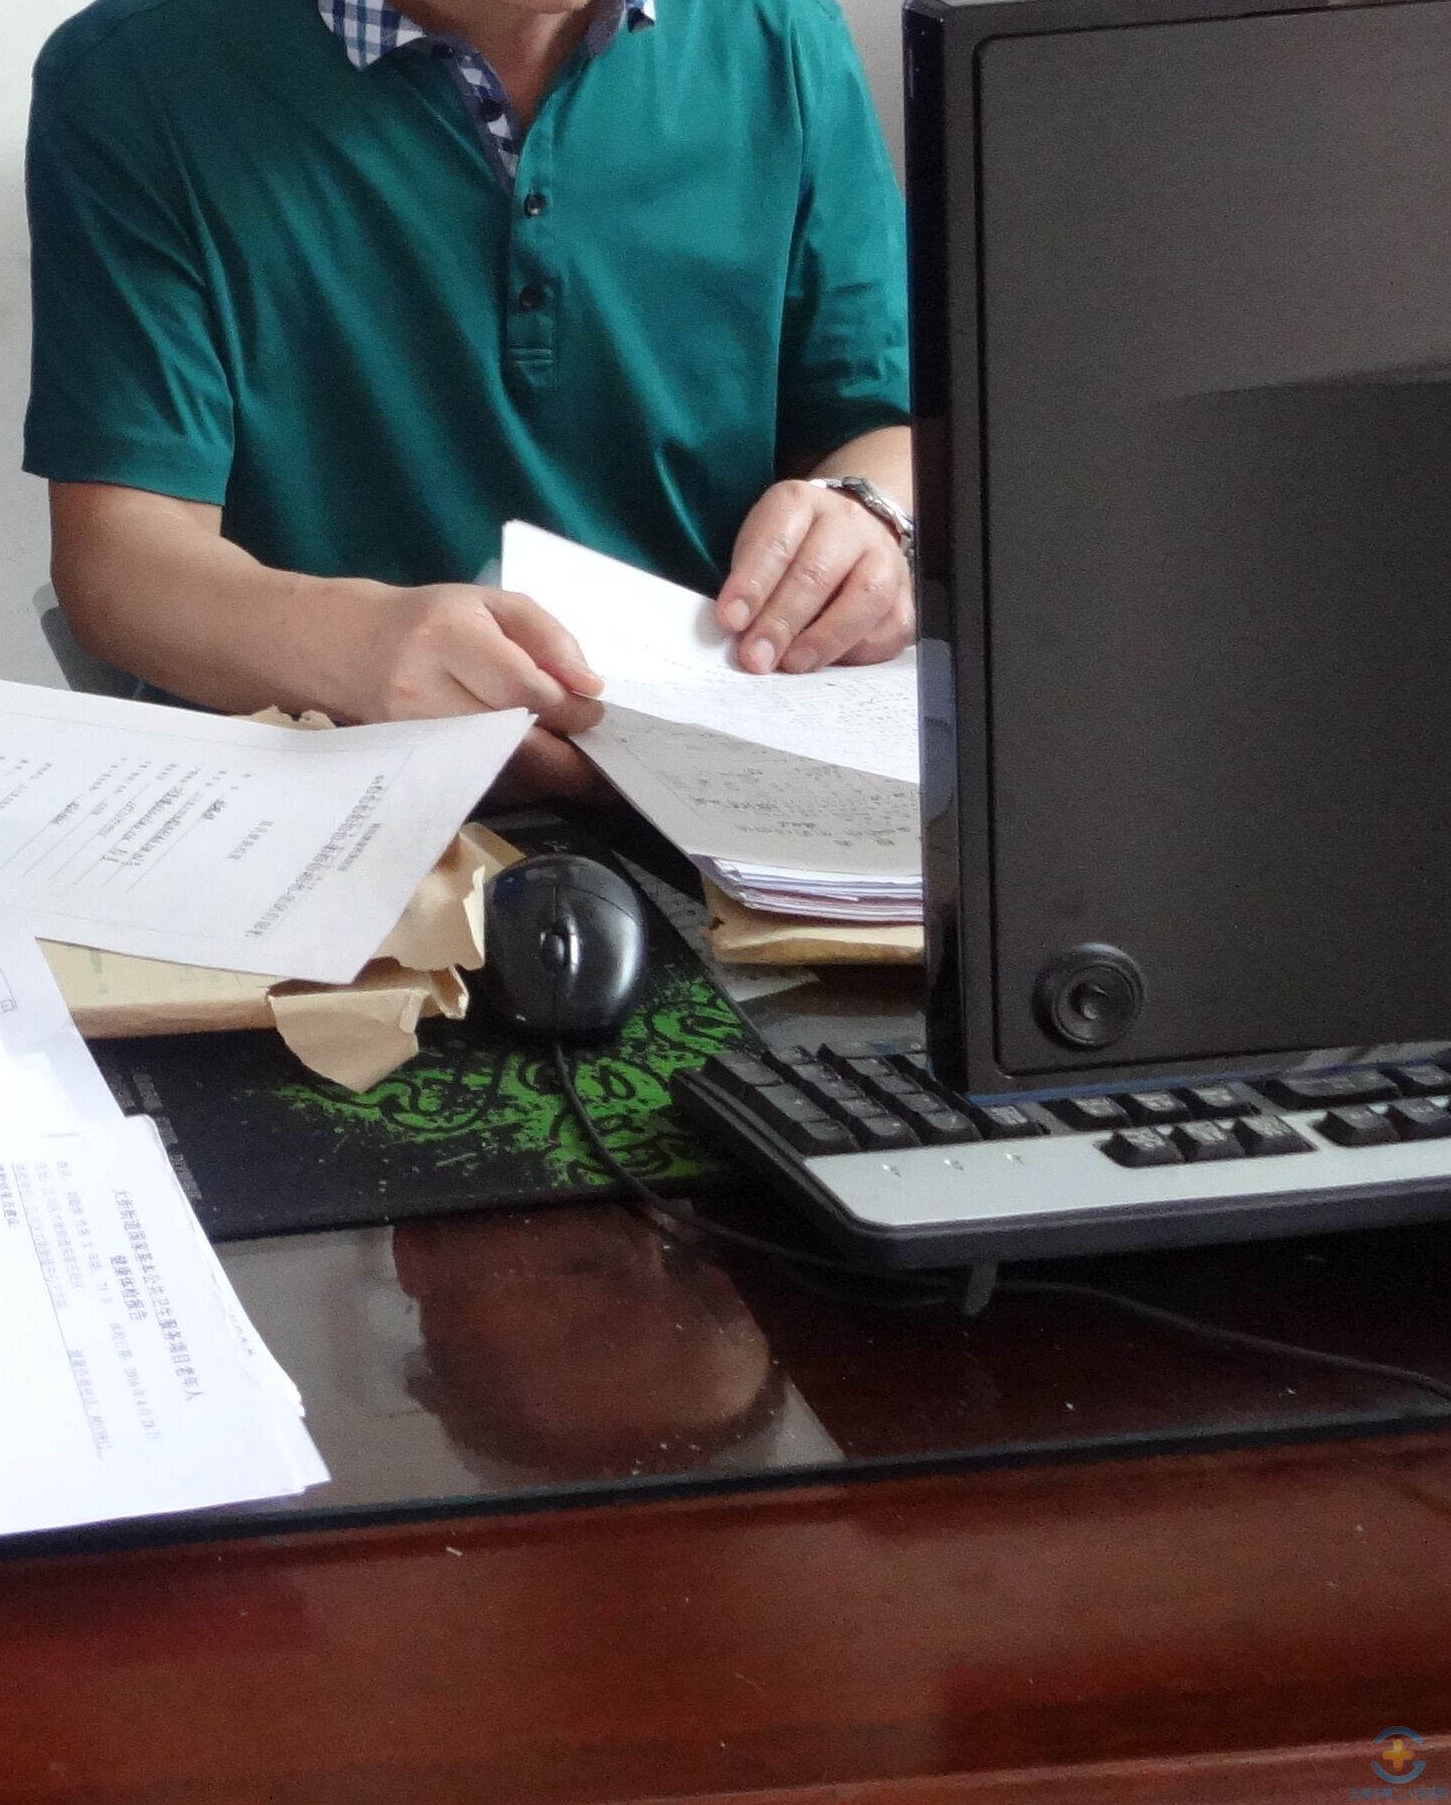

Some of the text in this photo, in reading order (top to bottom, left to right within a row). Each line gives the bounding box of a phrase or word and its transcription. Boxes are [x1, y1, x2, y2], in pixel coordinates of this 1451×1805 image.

[109, 1254, 147, 1322] 健康体检报告
